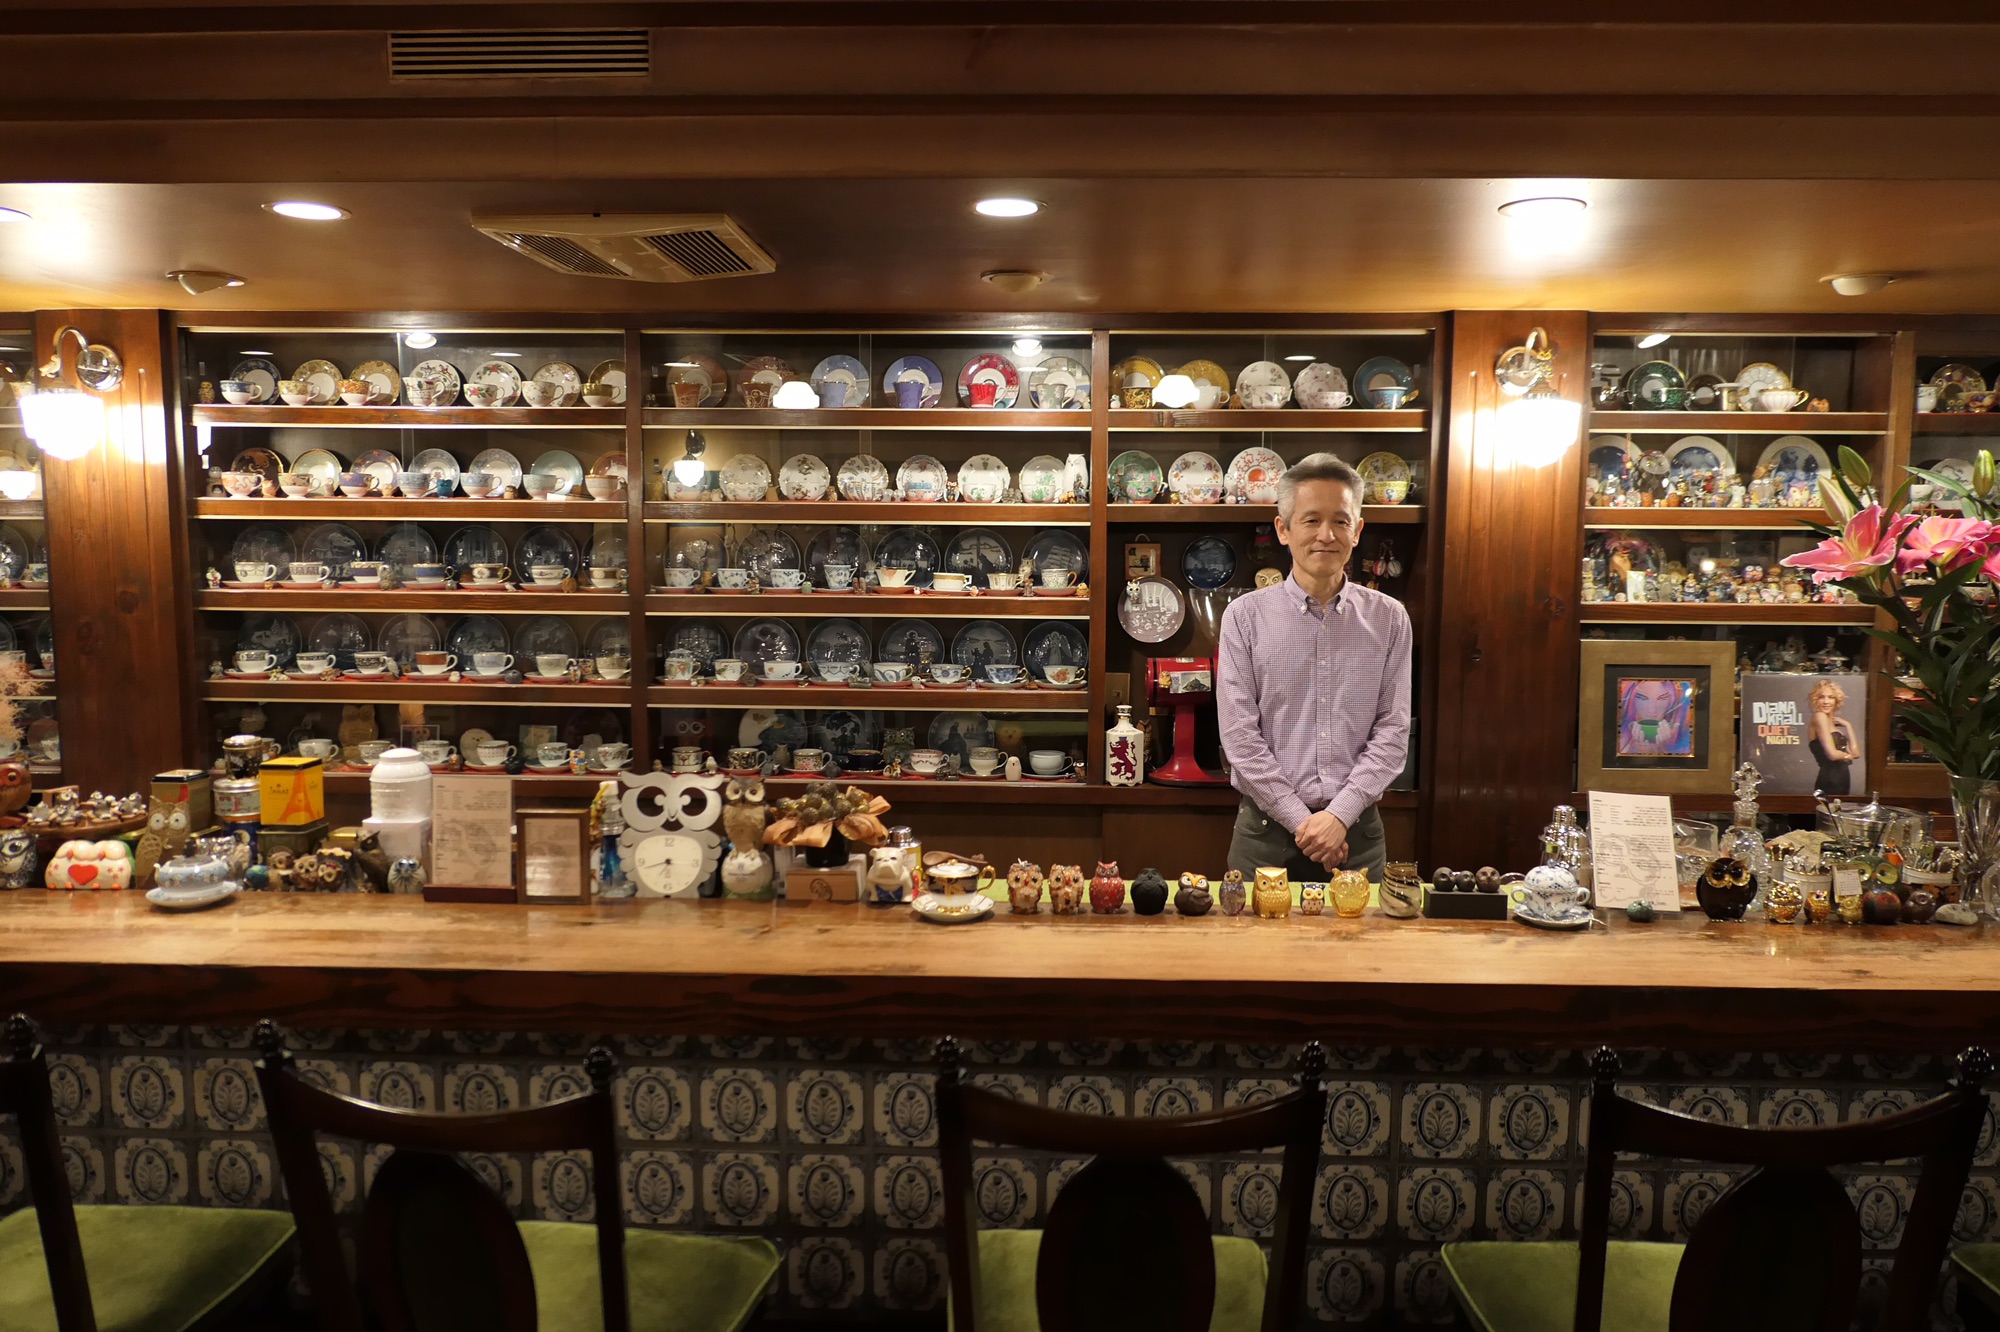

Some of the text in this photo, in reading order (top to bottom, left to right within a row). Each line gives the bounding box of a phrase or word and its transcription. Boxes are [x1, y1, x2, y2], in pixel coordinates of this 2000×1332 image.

[1758, 725, 1791, 737] QUIET
[1766, 735, 1801, 745] NIGHTS
[664, 837, 675, 847] 12
[637, 858, 645, 867] 9
[692, 859, 699, 868] 3
